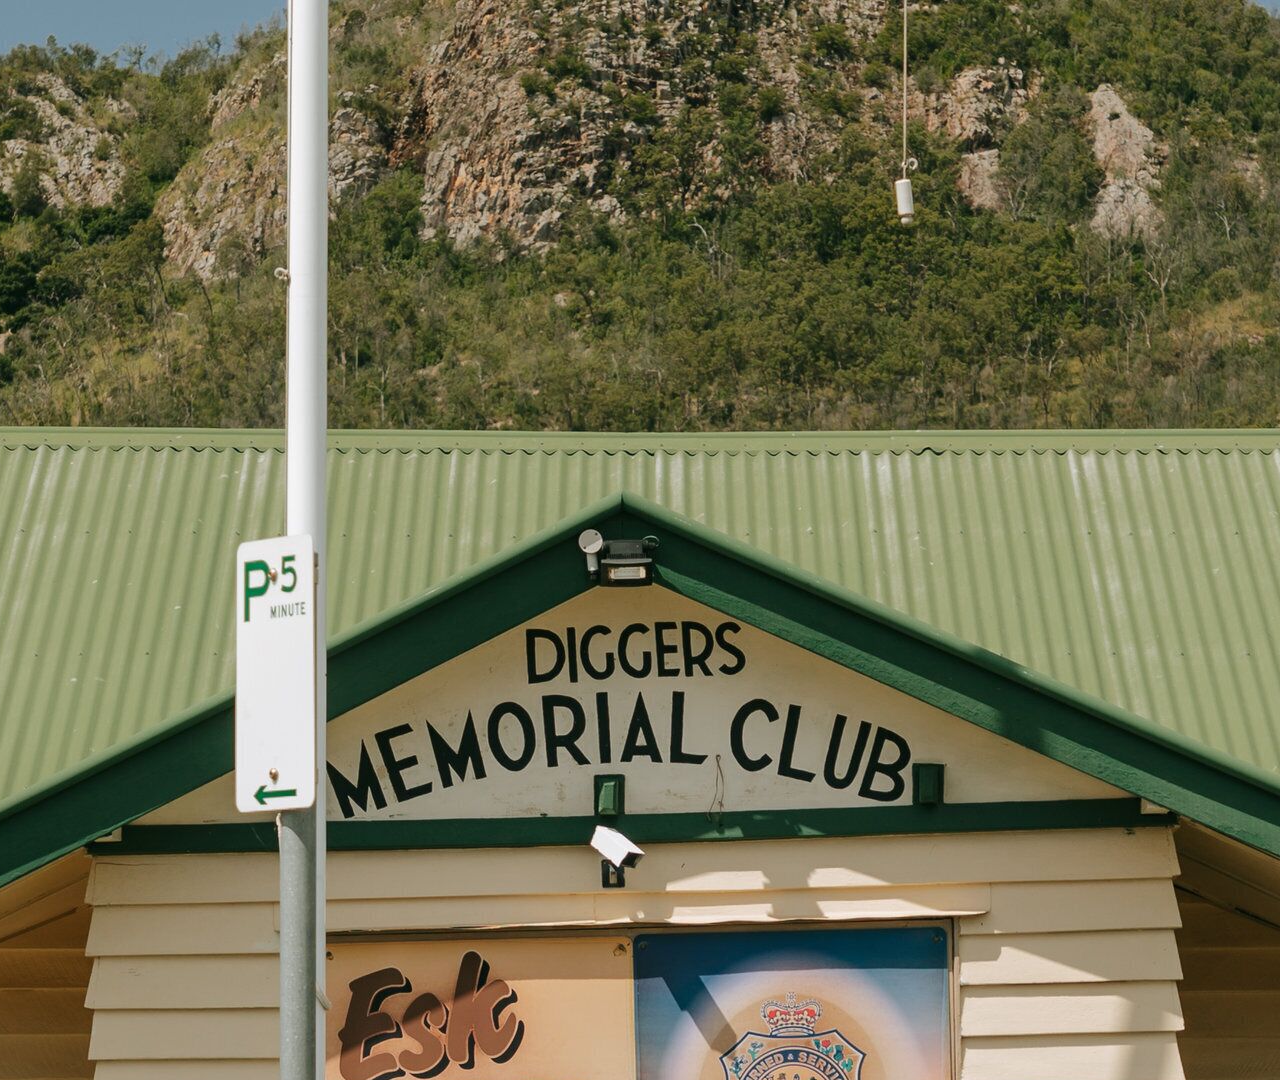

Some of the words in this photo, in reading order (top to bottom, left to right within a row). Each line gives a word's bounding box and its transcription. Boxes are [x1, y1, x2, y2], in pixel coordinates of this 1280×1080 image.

[243, 559, 270, 623] P
[280, 554, 298, 594] 5
[270, 601, 307, 619] MINUTE
[525, 620, 747, 684] DIGGERS
[326, 690, 709, 819] MEMORIAL
[729, 697, 913, 802] CLUB
[787, 1053, 795, 1061] &
